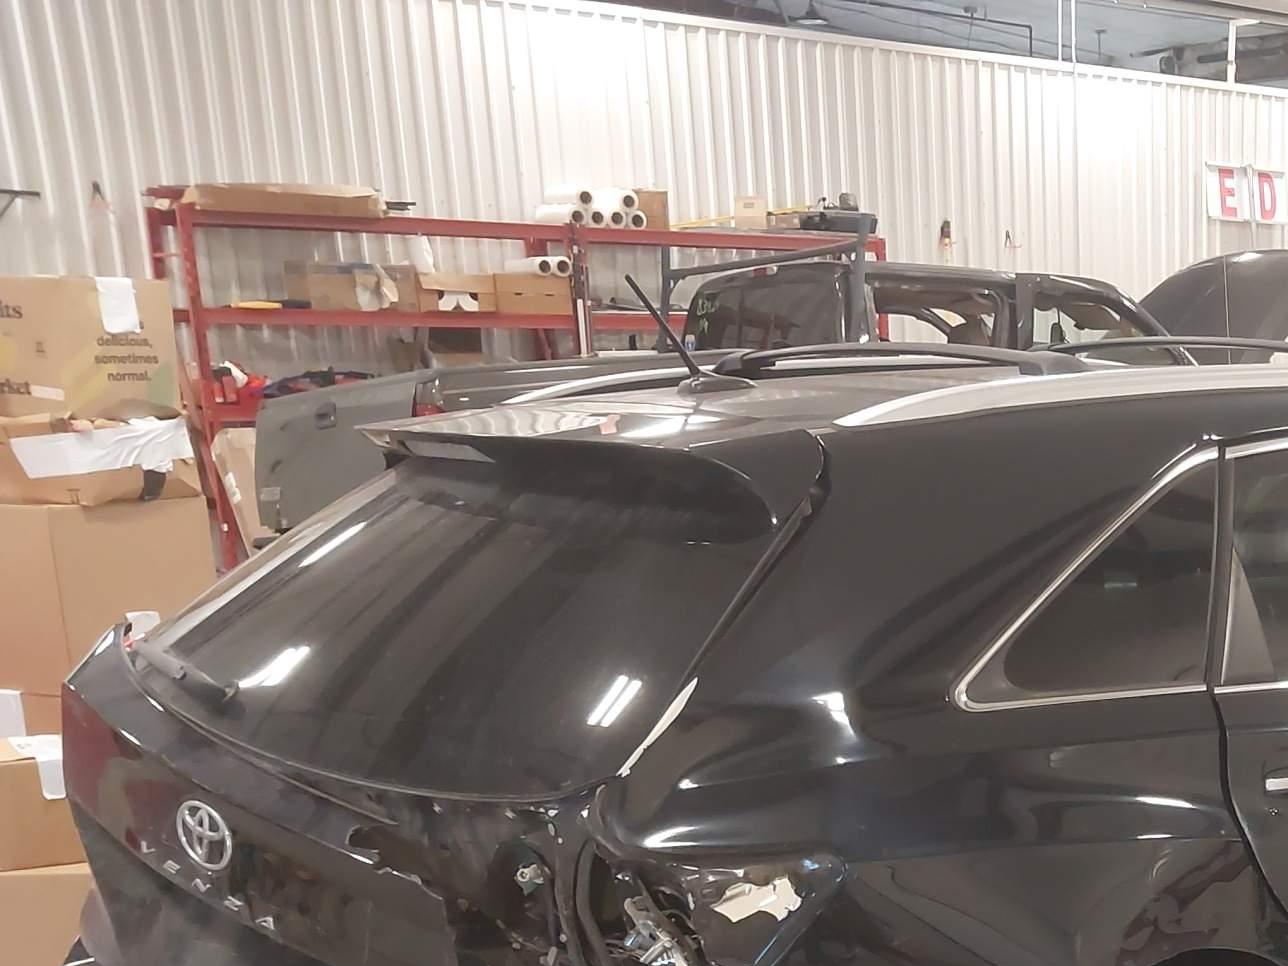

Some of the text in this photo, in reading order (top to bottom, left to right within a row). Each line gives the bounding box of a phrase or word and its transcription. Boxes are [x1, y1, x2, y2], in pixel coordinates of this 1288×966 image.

[1218, 168, 1276, 220] E D
[96, 334, 153, 349] delicious,
[94, 353, 159, 364] sometimes
[107, 370, 152, 381] normal.
[140, 840, 276, 930] VENZA
